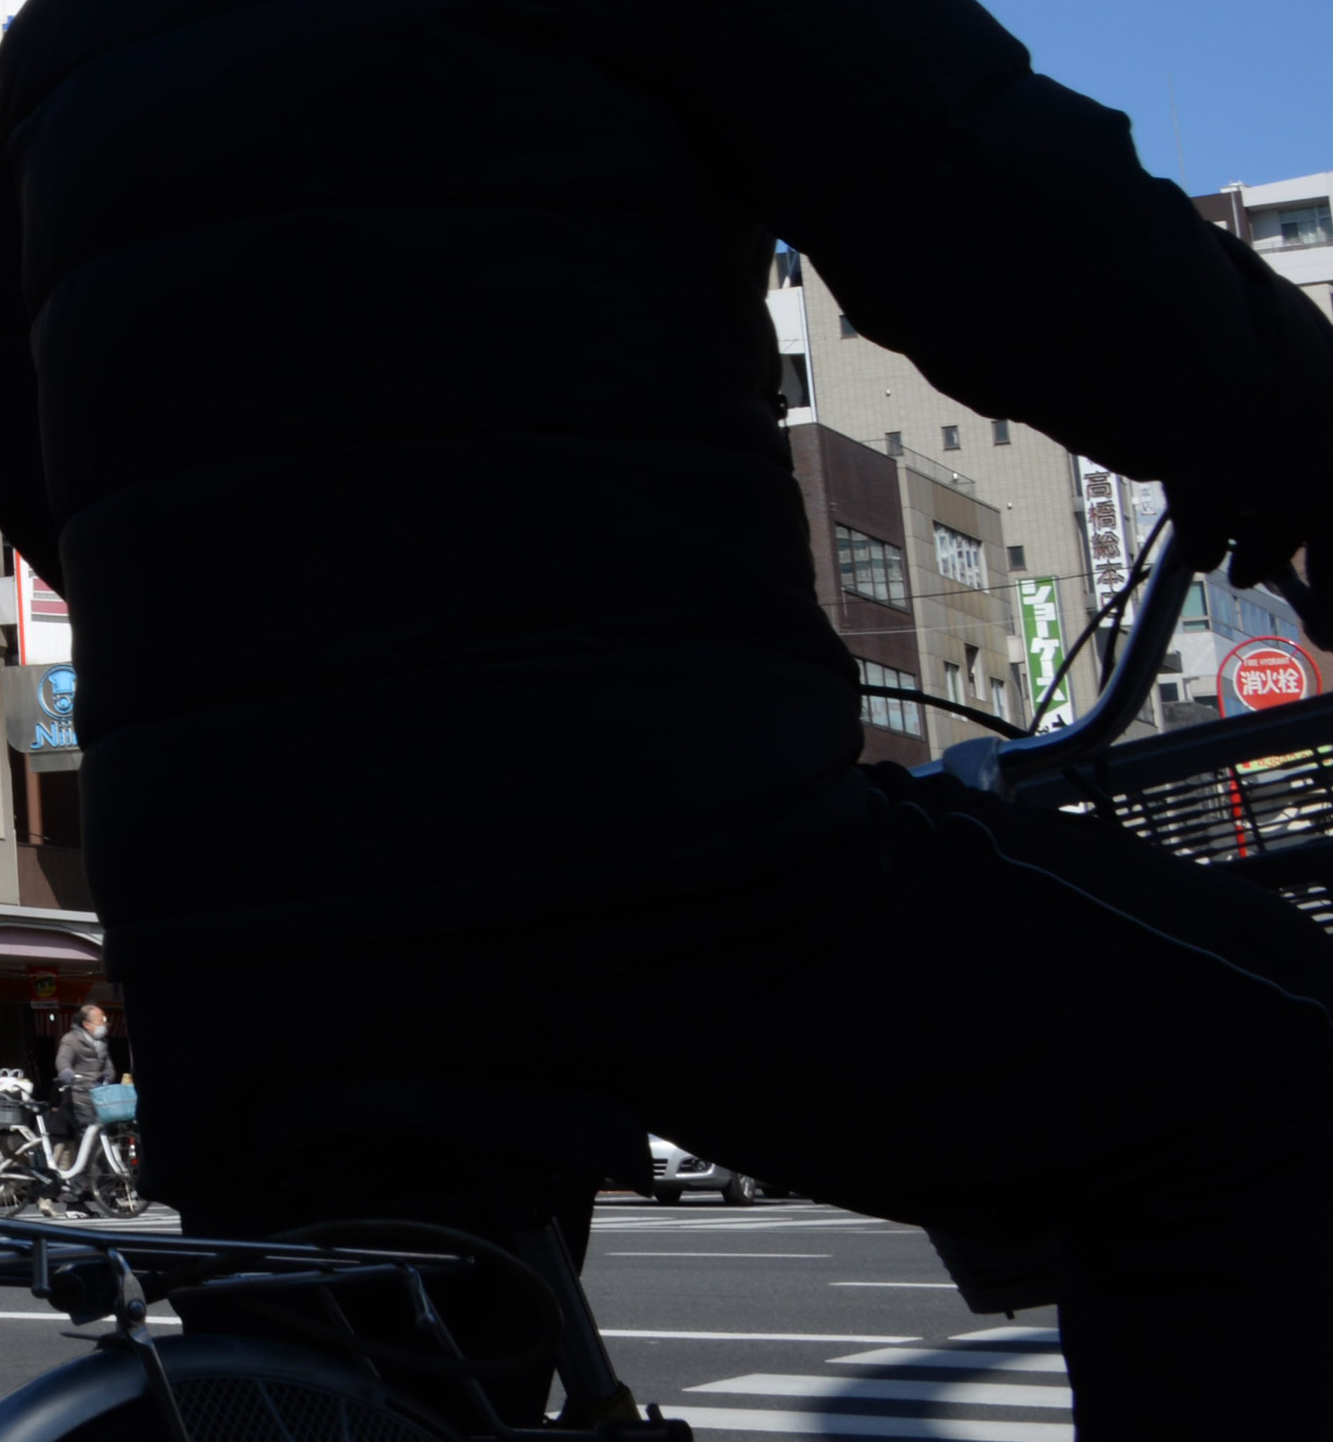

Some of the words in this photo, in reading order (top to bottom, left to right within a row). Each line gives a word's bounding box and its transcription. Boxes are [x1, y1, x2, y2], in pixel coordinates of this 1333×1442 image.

[1021, 578, 1065, 702] ショーケース
[1240, 667, 1300, 695] 消火栓
[30, 719, 79, 750] Nii
